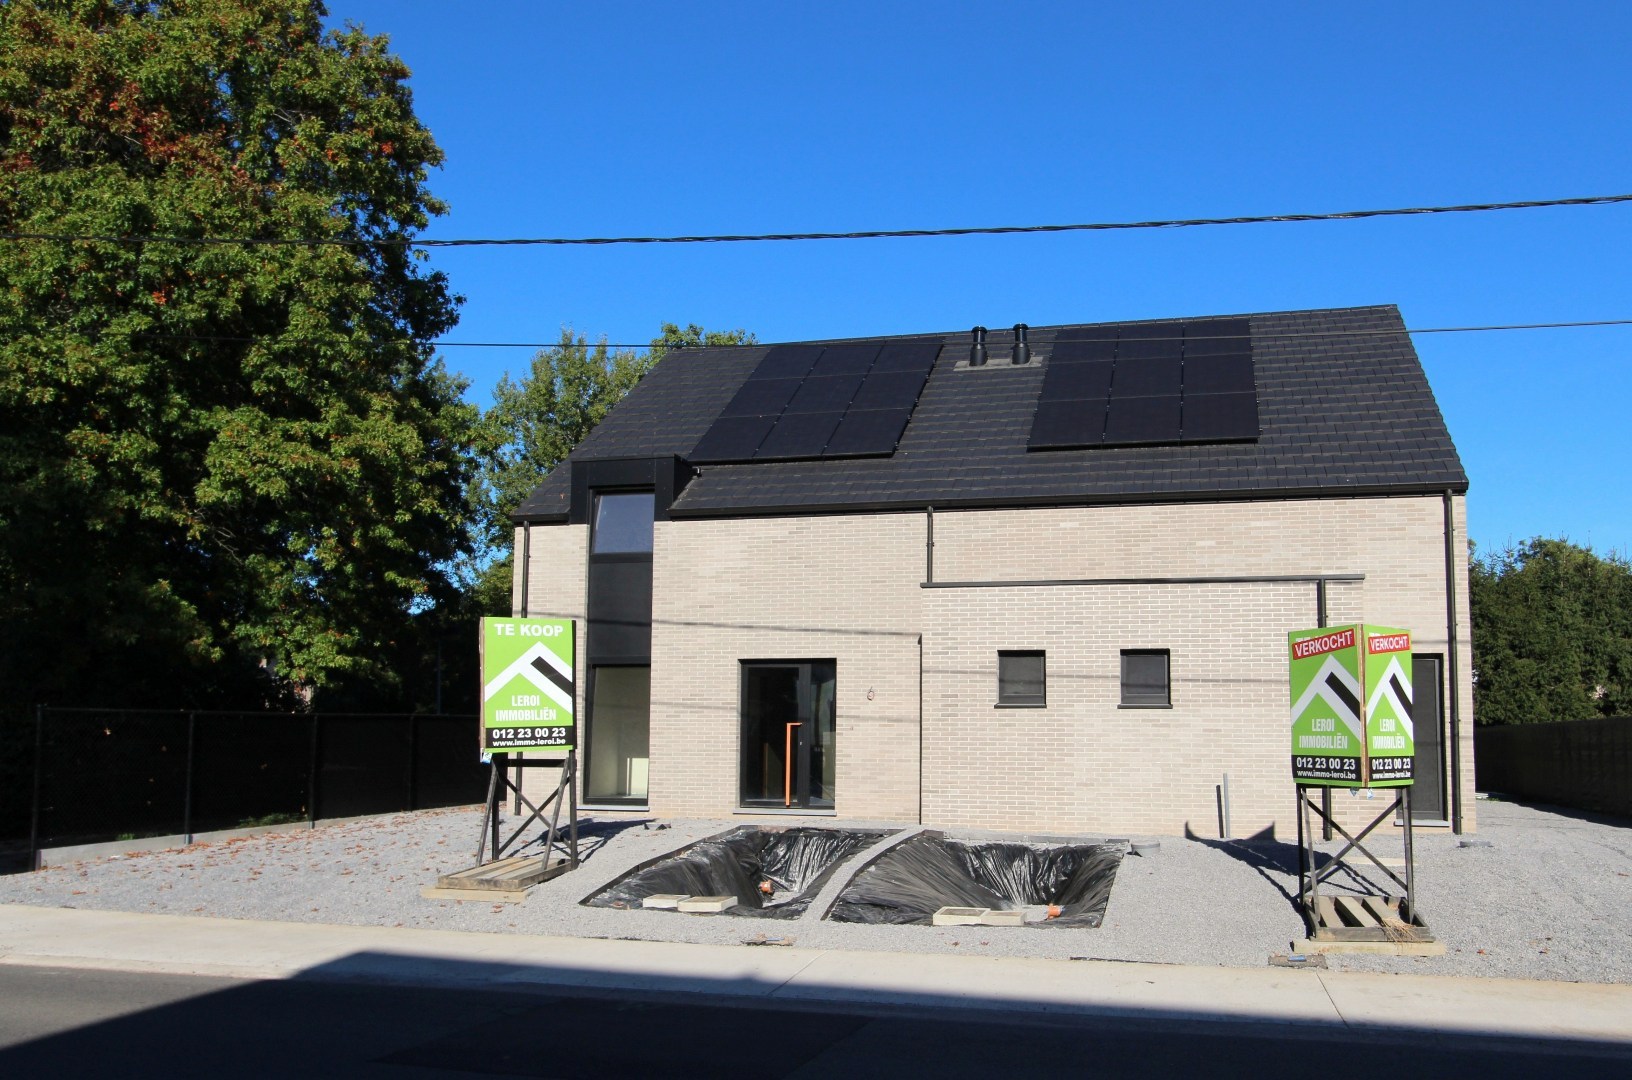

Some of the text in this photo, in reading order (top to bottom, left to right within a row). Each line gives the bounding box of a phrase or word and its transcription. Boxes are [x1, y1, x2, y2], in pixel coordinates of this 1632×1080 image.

[495, 624, 563, 637] TE KOOP
[1295, 631, 1352, 656] VERKOCHT
[1370, 636, 1408, 650] VERKOCHT
[512, 695, 540, 706] LEROI
[496, 707, 556, 721] IMMOBILIËN
[1312, 719, 1334, 731] LEROI
[1380, 719, 1396, 732] LEROI
[493, 728, 566, 739] 012 23 00 23
[493, 738, 566, 747] www.immo-leroi.be
[1299, 733, 1348, 749] IMMOBILIËN
[1373, 733, 1405, 749] IMMOBILIËN
[1297, 757, 1355, 769] 012 23 00 23
[1372, 758, 1411, 770] 012 23 00 23
[1297, 770, 1356, 779] www.immo-leroi.be
